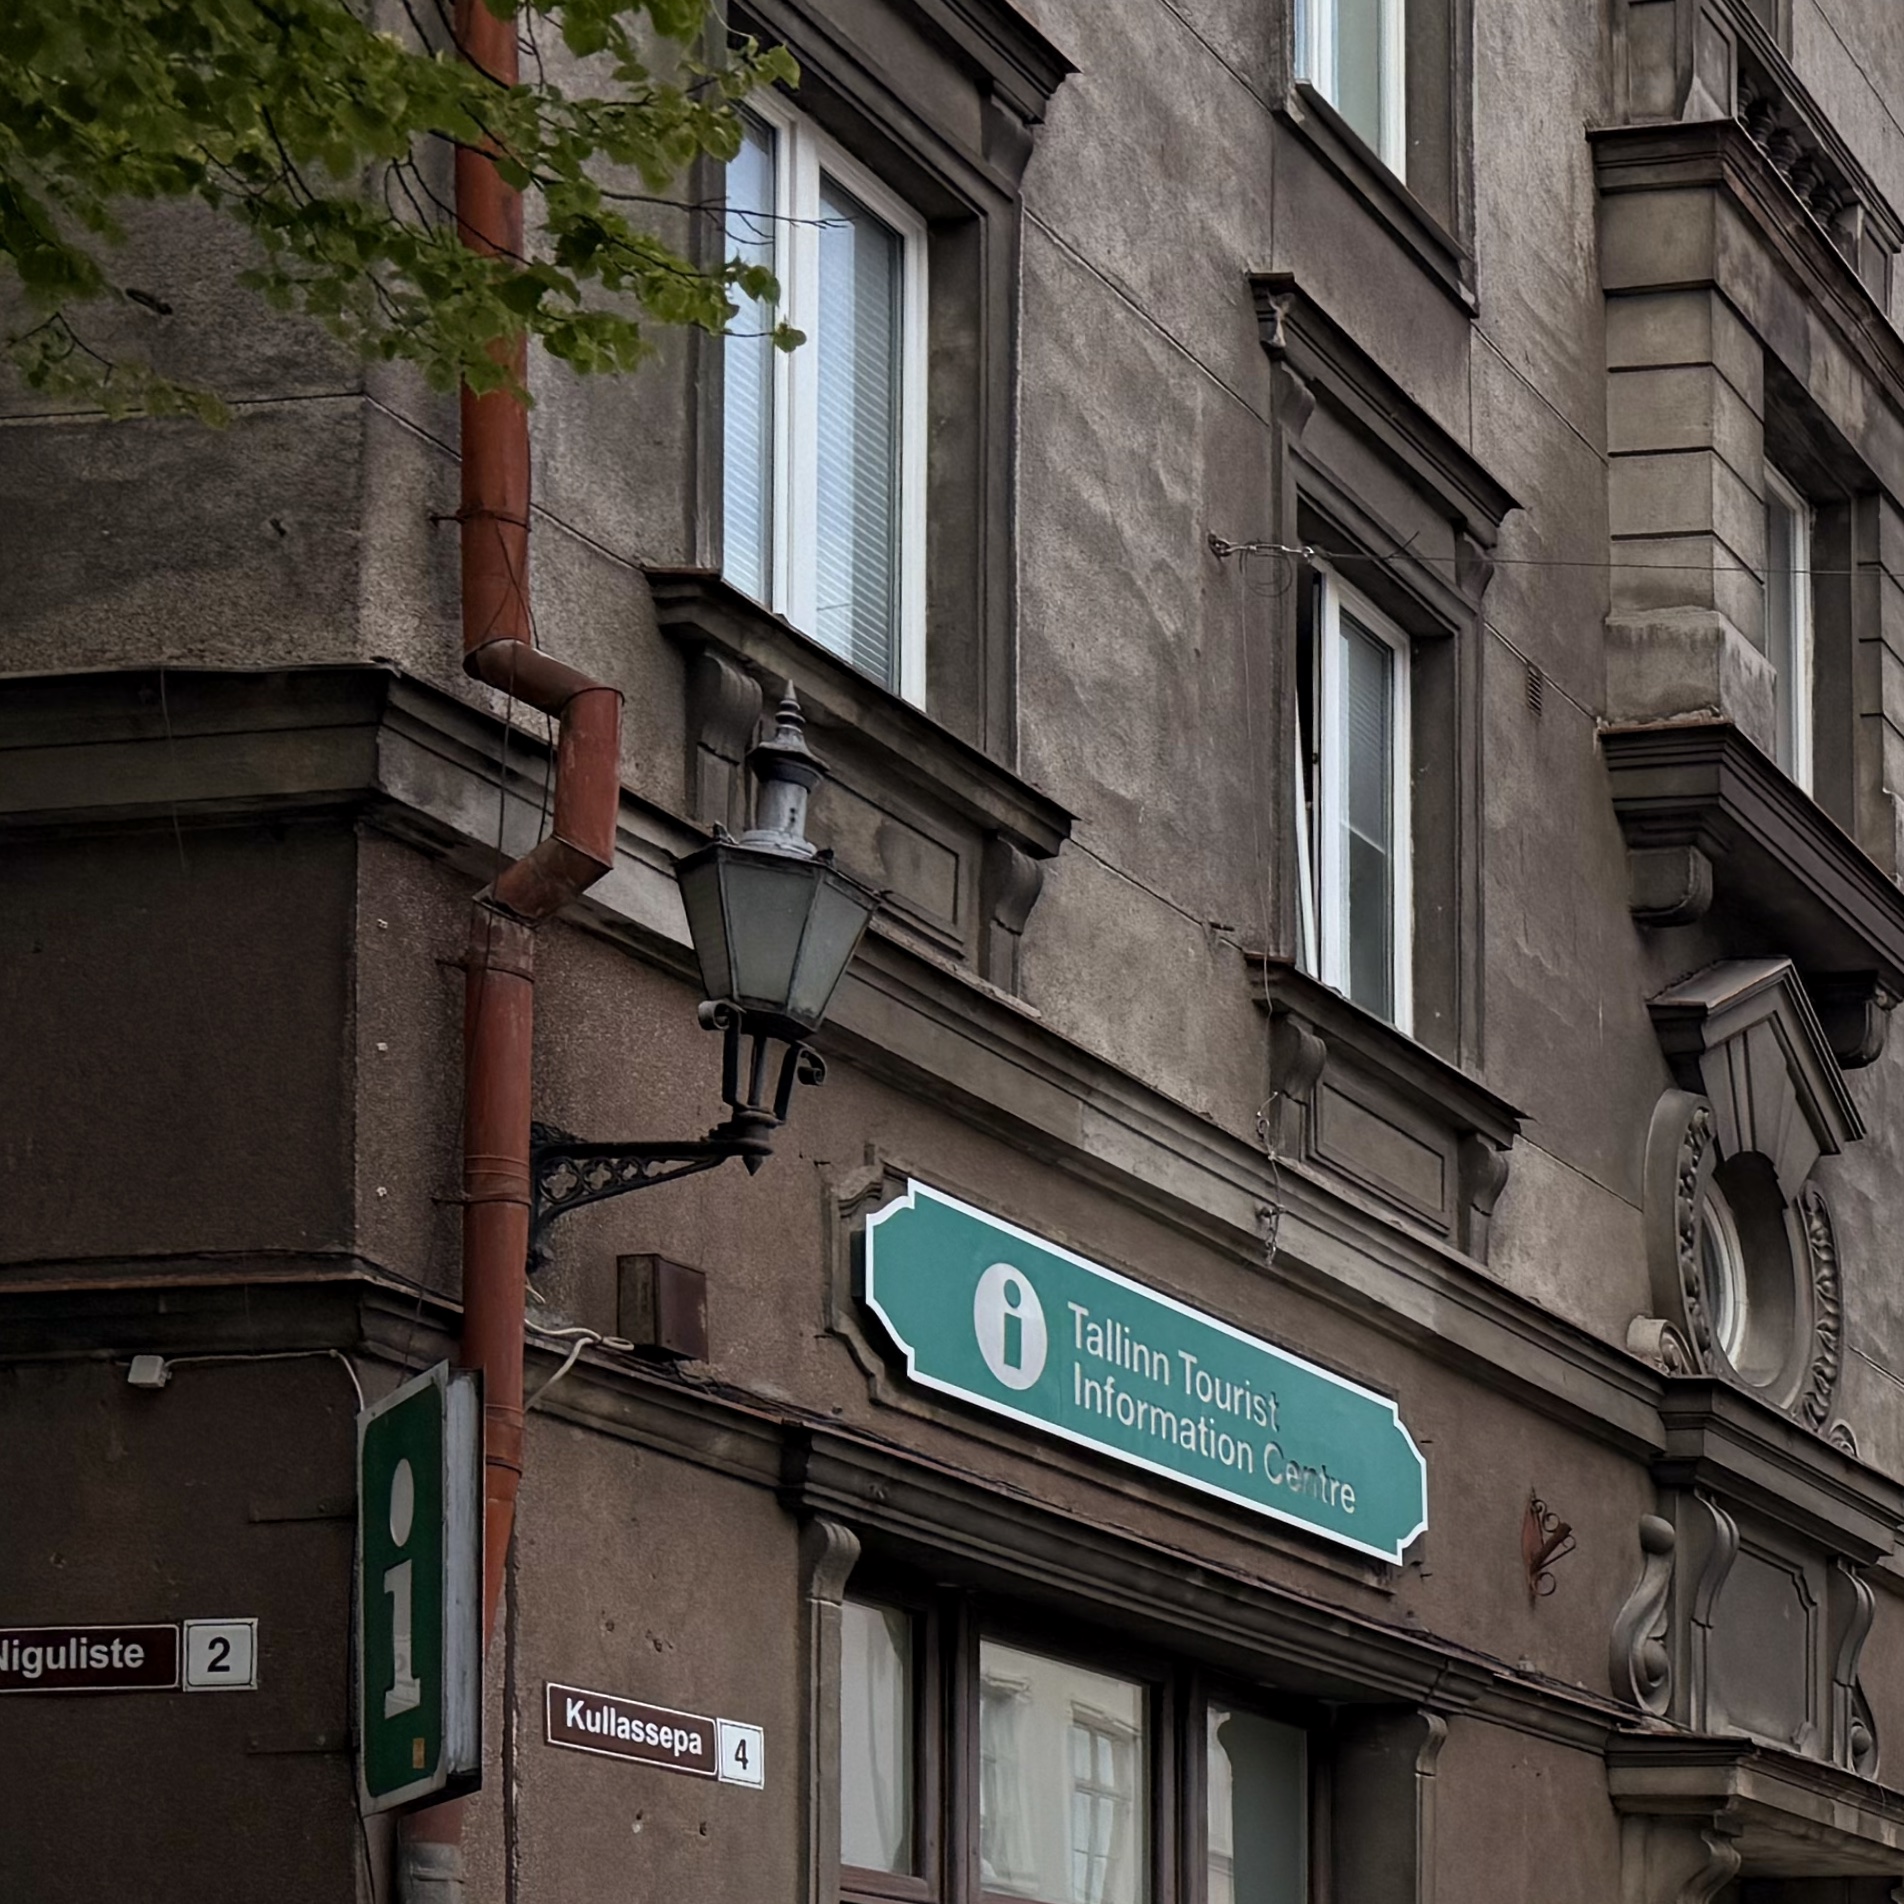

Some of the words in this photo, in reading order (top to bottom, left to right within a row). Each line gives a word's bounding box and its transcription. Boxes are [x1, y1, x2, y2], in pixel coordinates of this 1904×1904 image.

[1067, 1301, 1171, 1386] Tallinn
[1178, 1350, 1281, 1432] Tourist
[1073, 1362, 1254, 1474] Information
[1263, 1441, 1357, 1515] Centre
[207, 1636, 231, 1672] 2
[566, 1698, 702, 1757] Kullassepa
[735, 1738, 749, 1770] 4
